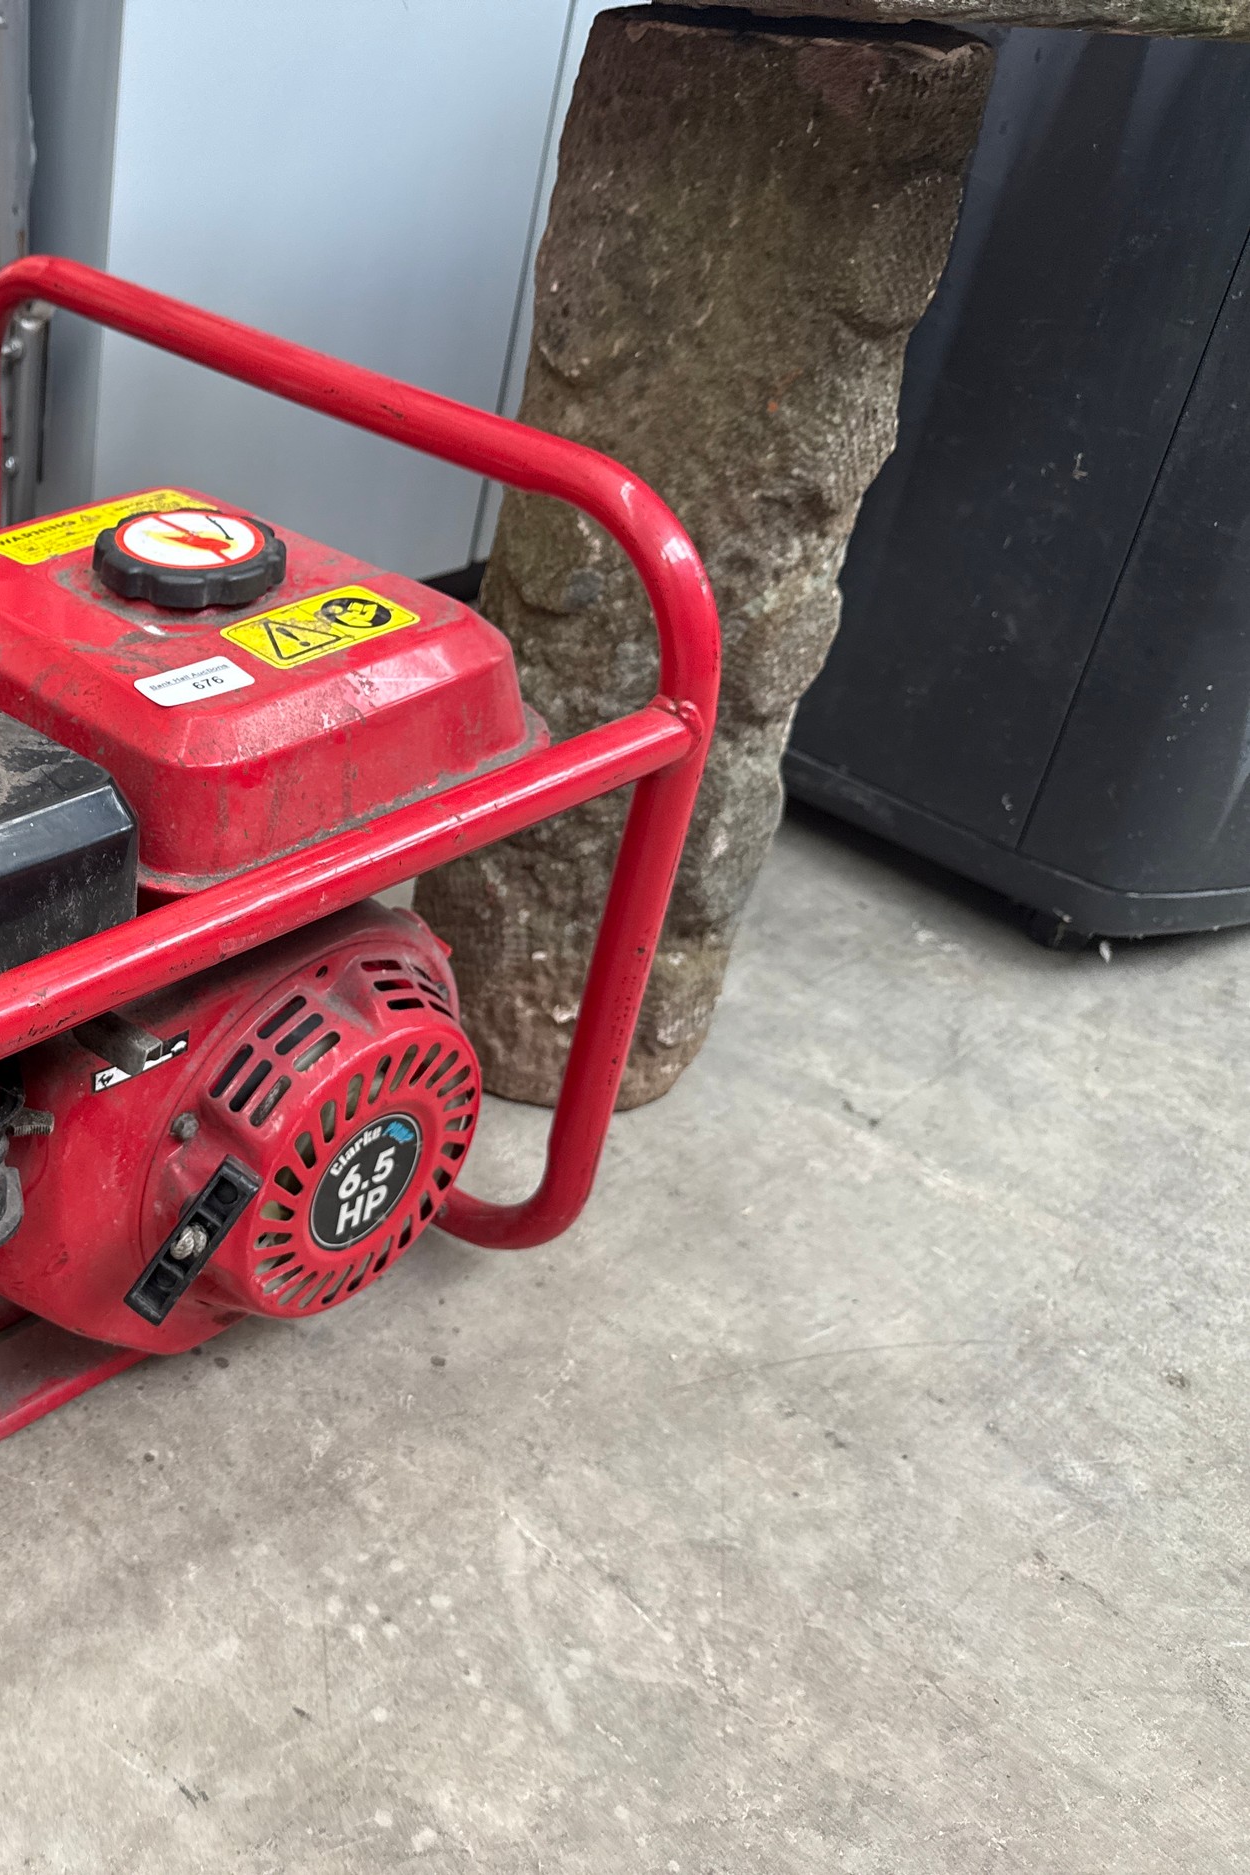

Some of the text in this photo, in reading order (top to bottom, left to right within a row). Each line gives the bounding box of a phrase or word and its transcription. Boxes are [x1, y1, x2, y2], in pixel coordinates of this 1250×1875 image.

[191, 664, 230, 678] Auctions
[192, 676, 224, 690] 676
[330, 1126, 382, 1176] Clarke
[338, 1146, 396, 1200] 6.5
[335, 1184, 388, 1236] HP
